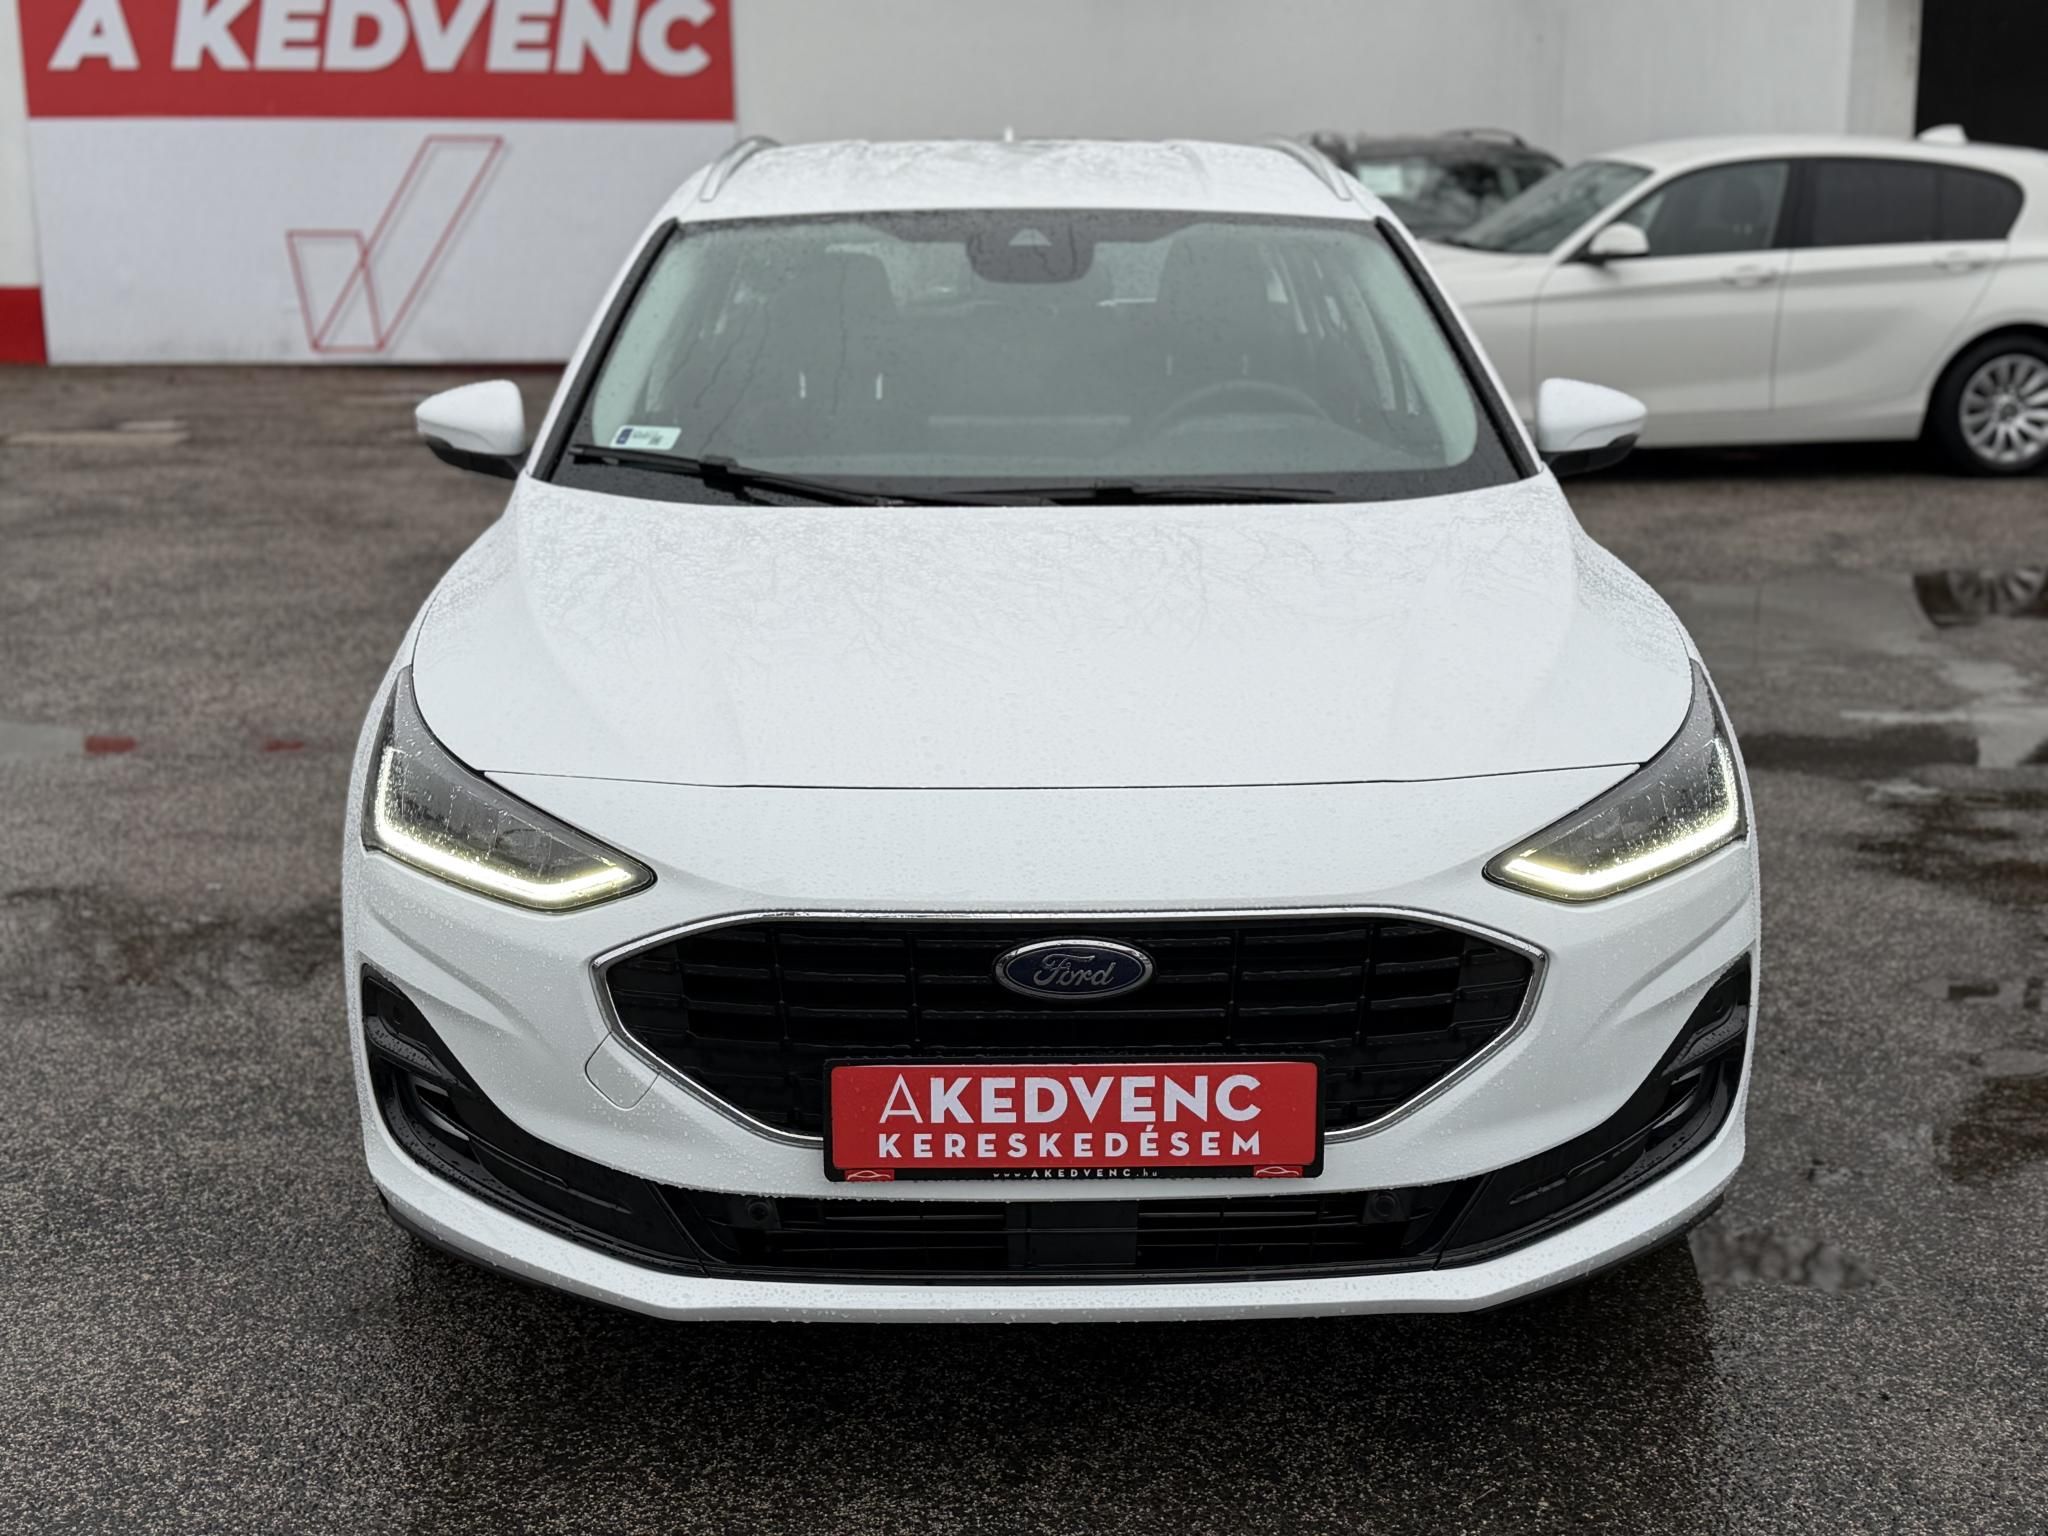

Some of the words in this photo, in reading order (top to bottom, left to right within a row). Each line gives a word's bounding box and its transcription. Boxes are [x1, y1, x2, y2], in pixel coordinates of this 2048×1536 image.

[47, 0, 140, 69] A
[171, 0, 713, 76] KEDVENC
[1033, 953, 1117, 986] Ford
[878, 1124, 1261, 1159] KERESKEDÉSEM
